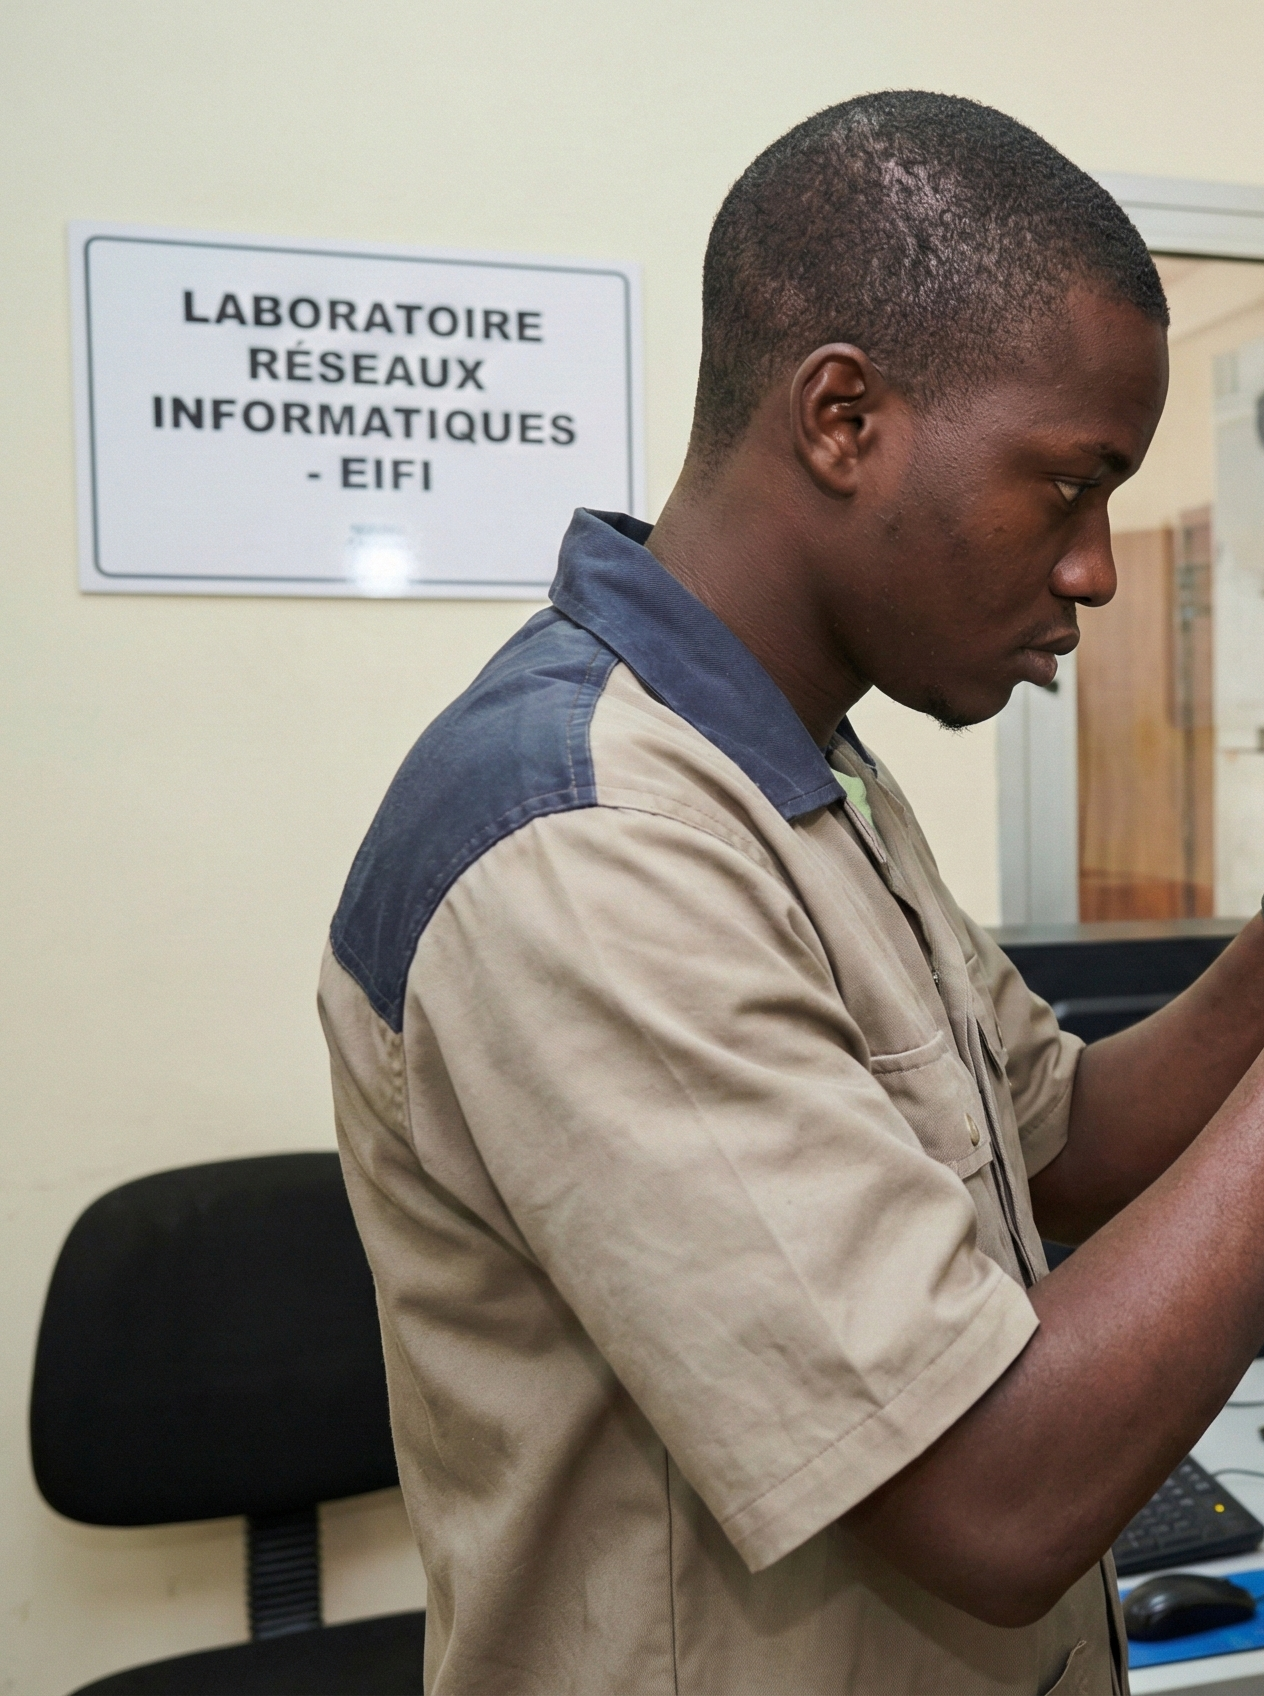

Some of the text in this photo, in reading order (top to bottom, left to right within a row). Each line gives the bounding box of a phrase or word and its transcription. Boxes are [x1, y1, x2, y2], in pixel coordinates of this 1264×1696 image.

[182, 289, 544, 344] LABORATOIRE
[248, 341, 486, 391] RÉSEAUX
[151, 394, 577, 448] INFORMATIQUES
[339, 456, 434, 493] EIFI
